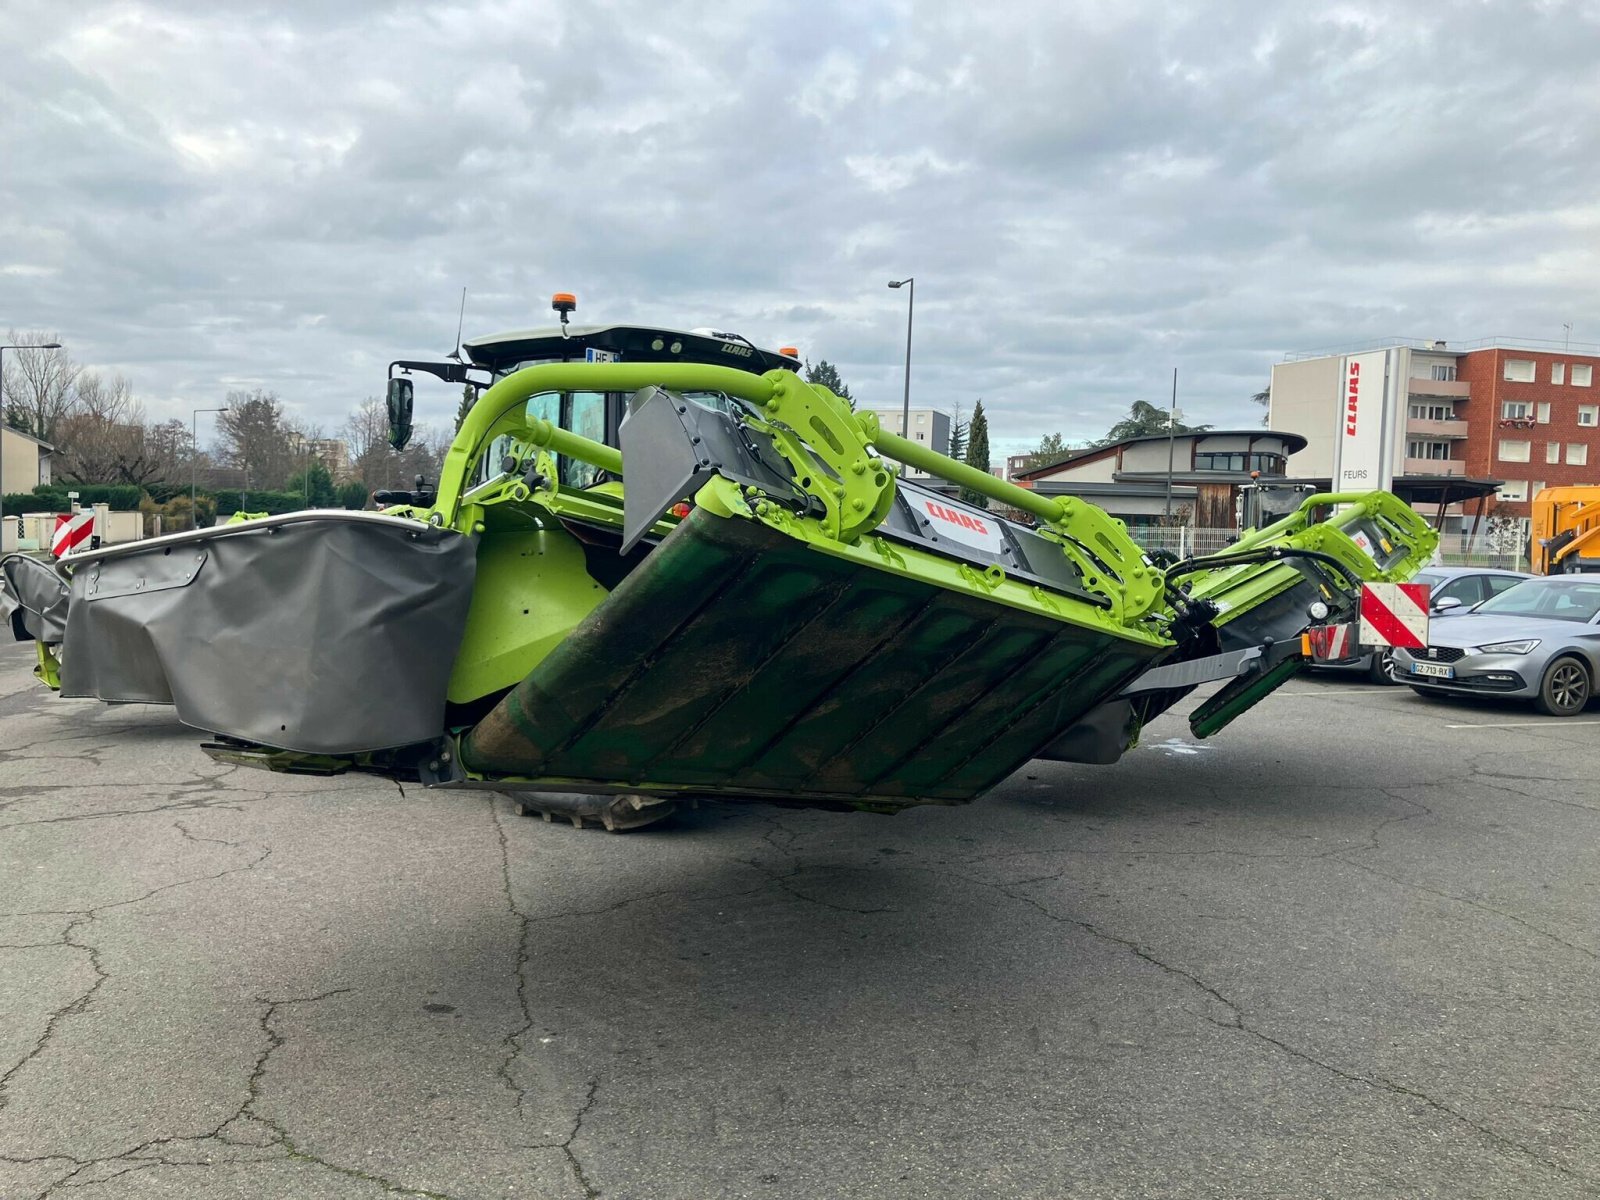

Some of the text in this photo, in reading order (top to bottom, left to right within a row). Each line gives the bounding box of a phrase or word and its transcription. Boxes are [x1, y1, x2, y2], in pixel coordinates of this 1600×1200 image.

[721, 343, 754, 358] CLAAS
[1347, 362, 1360, 436] CLAAS
[1343, 470, 1368, 480] FEURS
[925, 501, 989, 535] CLAAS
